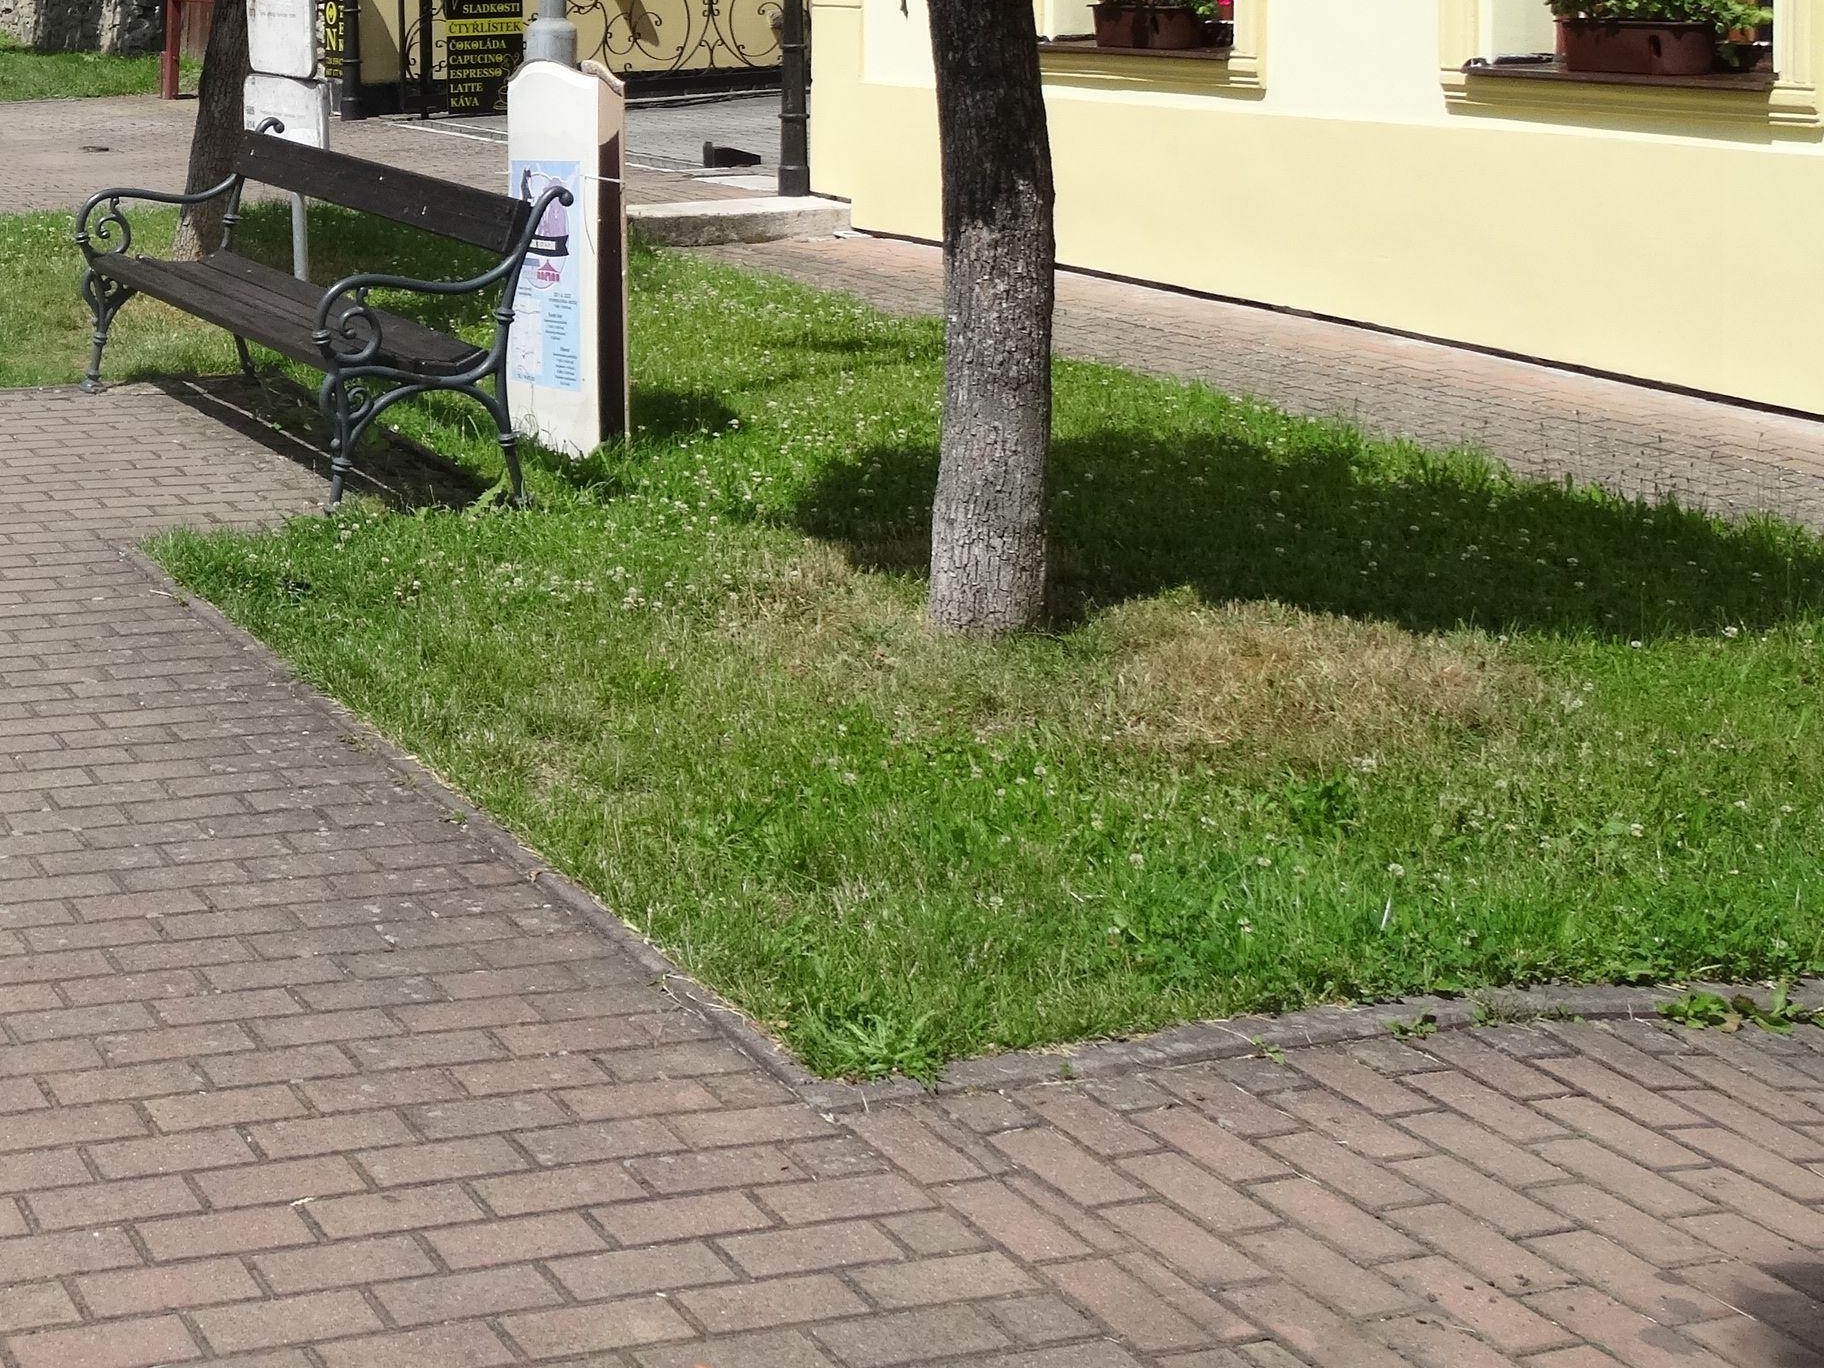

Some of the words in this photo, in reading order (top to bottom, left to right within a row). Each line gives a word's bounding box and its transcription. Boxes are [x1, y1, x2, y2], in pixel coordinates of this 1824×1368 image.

[462, 2, 521, 14] SLADKOSTI
[448, 20, 523, 34] ČTYŘLÍSTEK
[448, 38, 507, 51] ČOKOLÁDA
[449, 53, 504, 65] CAPUCINO
[449, 67, 503, 79] ESPRESSO
[449, 82, 484, 93] LATTE
[449, 95, 480, 107] KÁVA
